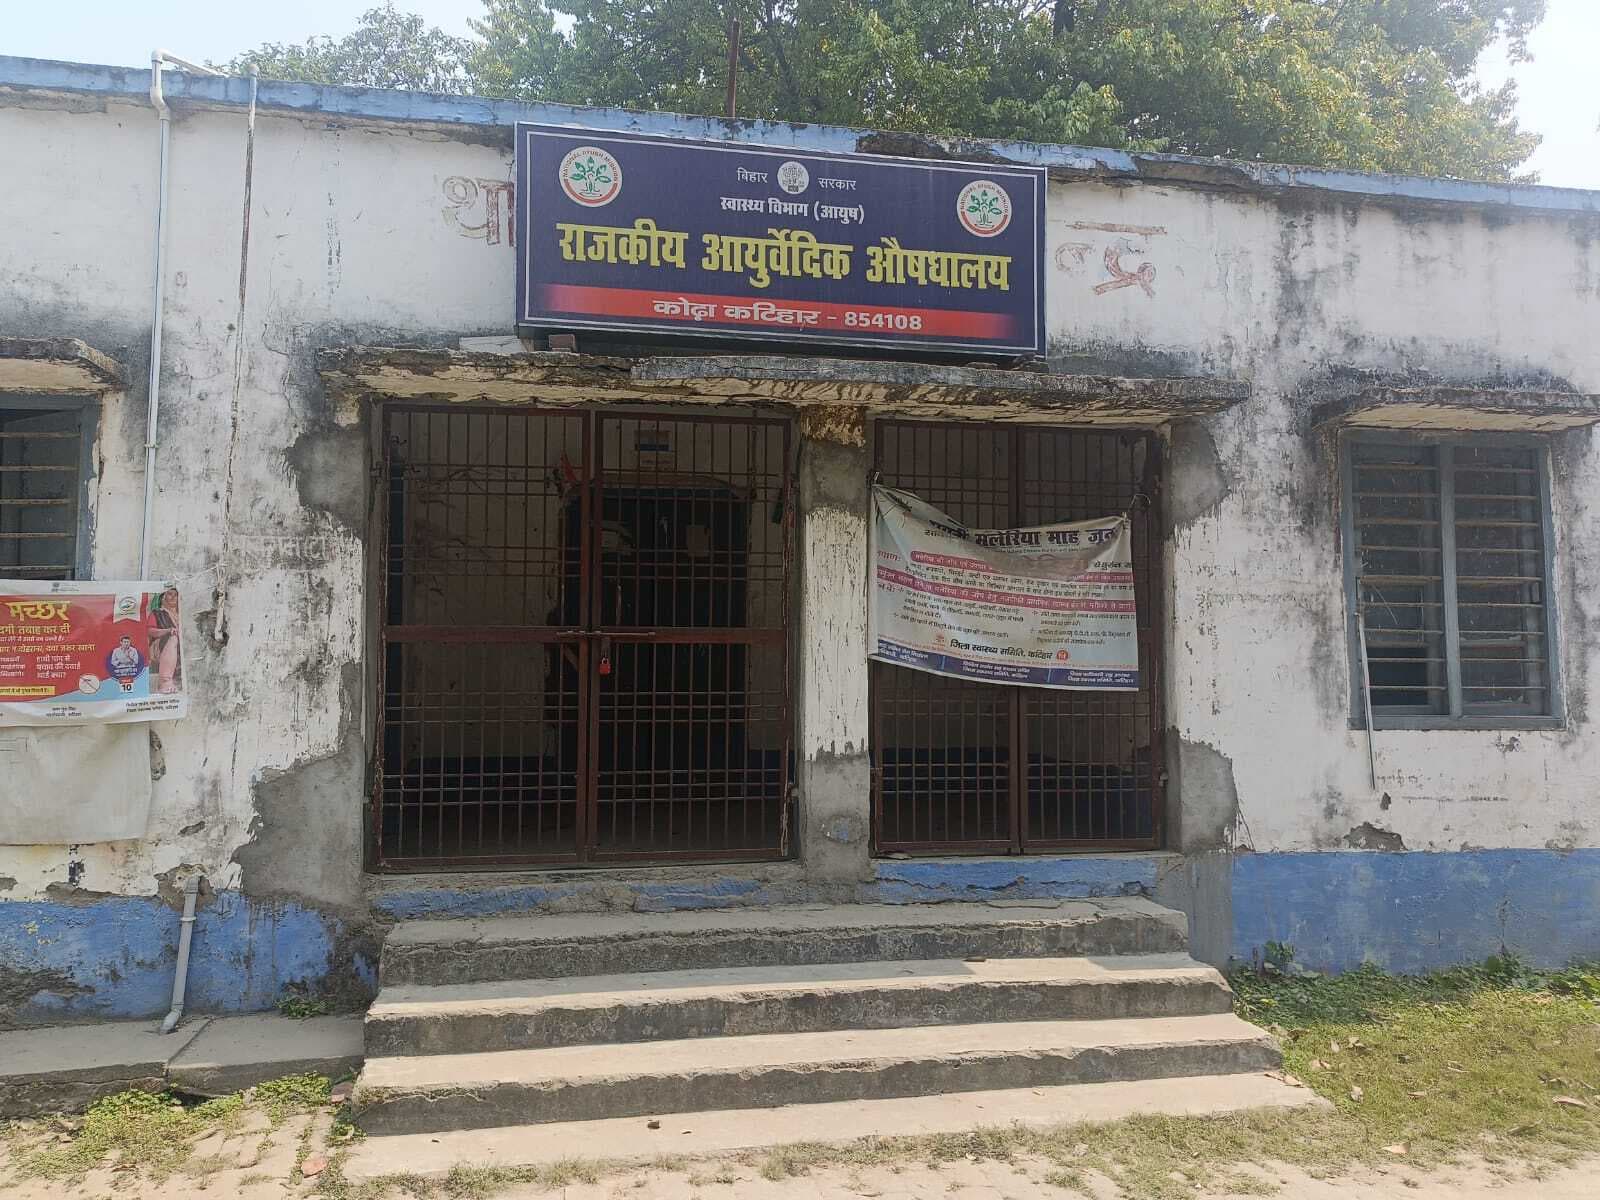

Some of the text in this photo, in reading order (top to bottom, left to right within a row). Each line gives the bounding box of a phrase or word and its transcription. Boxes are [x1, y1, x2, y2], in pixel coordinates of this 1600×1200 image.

[736, 166, 857, 191] बिहार सरकार
[720, 196, 866, 225] स्वास्थ्य विभाग (आयुष)
[556, 218, 689, 269] राजकीय
[702, 228, 854, 288] आयुर्वेदिक
[866, 236, 1012, 291] औषधालय
[723, 301, 821, 325] कटिहार
[844, 311, 922, 330] 854108
[1046, 530, 1081, 546] माह
[5, 600, 71, 621] मच्छर
[60, 622, 71, 634] दी
[950, 639, 970, 650] जिला
[972, 644, 998, 655] स्वास्थ्य
[1028, 649, 1053, 659] कटिहार
